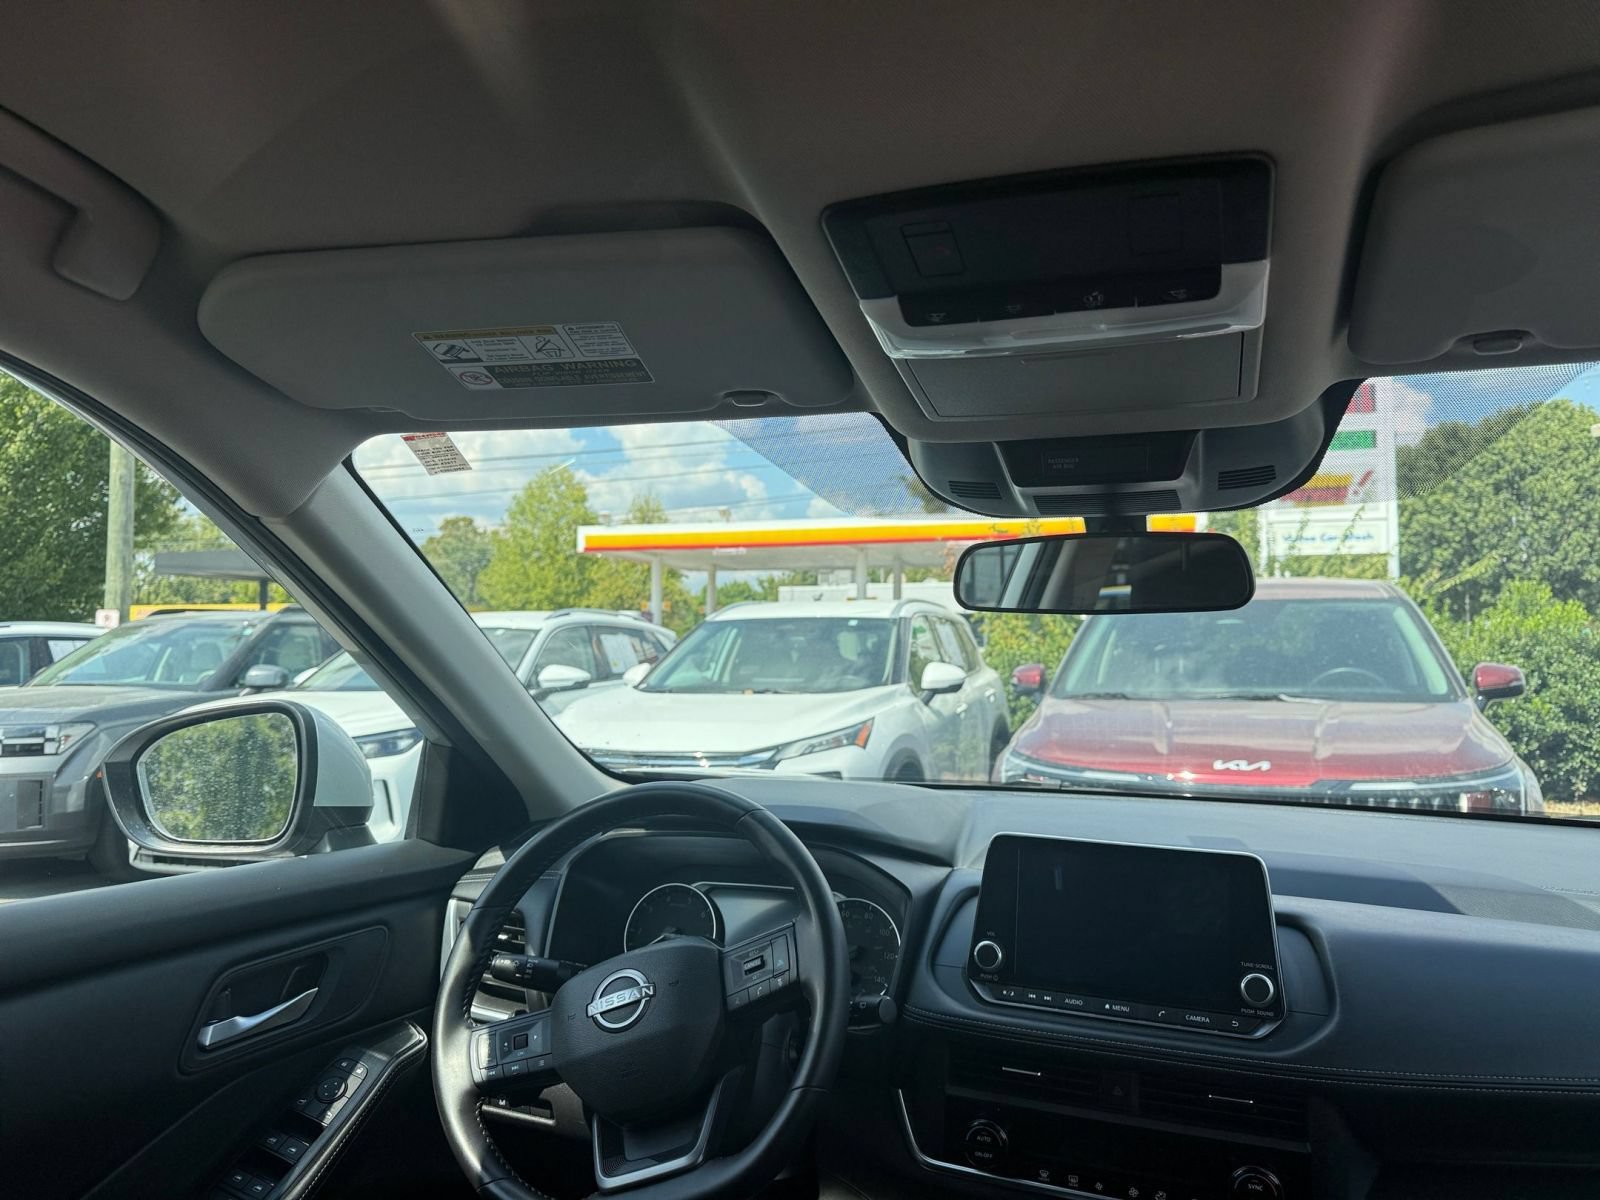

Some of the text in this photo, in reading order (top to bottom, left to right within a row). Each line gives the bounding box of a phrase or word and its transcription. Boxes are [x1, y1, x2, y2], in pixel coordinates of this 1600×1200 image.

[494, 364, 554, 374] AIRBAG
[560, 359, 638, 371] WARNING
[589, 985, 654, 1015] NISSAN
[1064, 998, 1084, 1006] AUDIO
[1112, 1004, 1130, 1013] MENU
[1185, 1013, 1210, 1024] CAMERA
